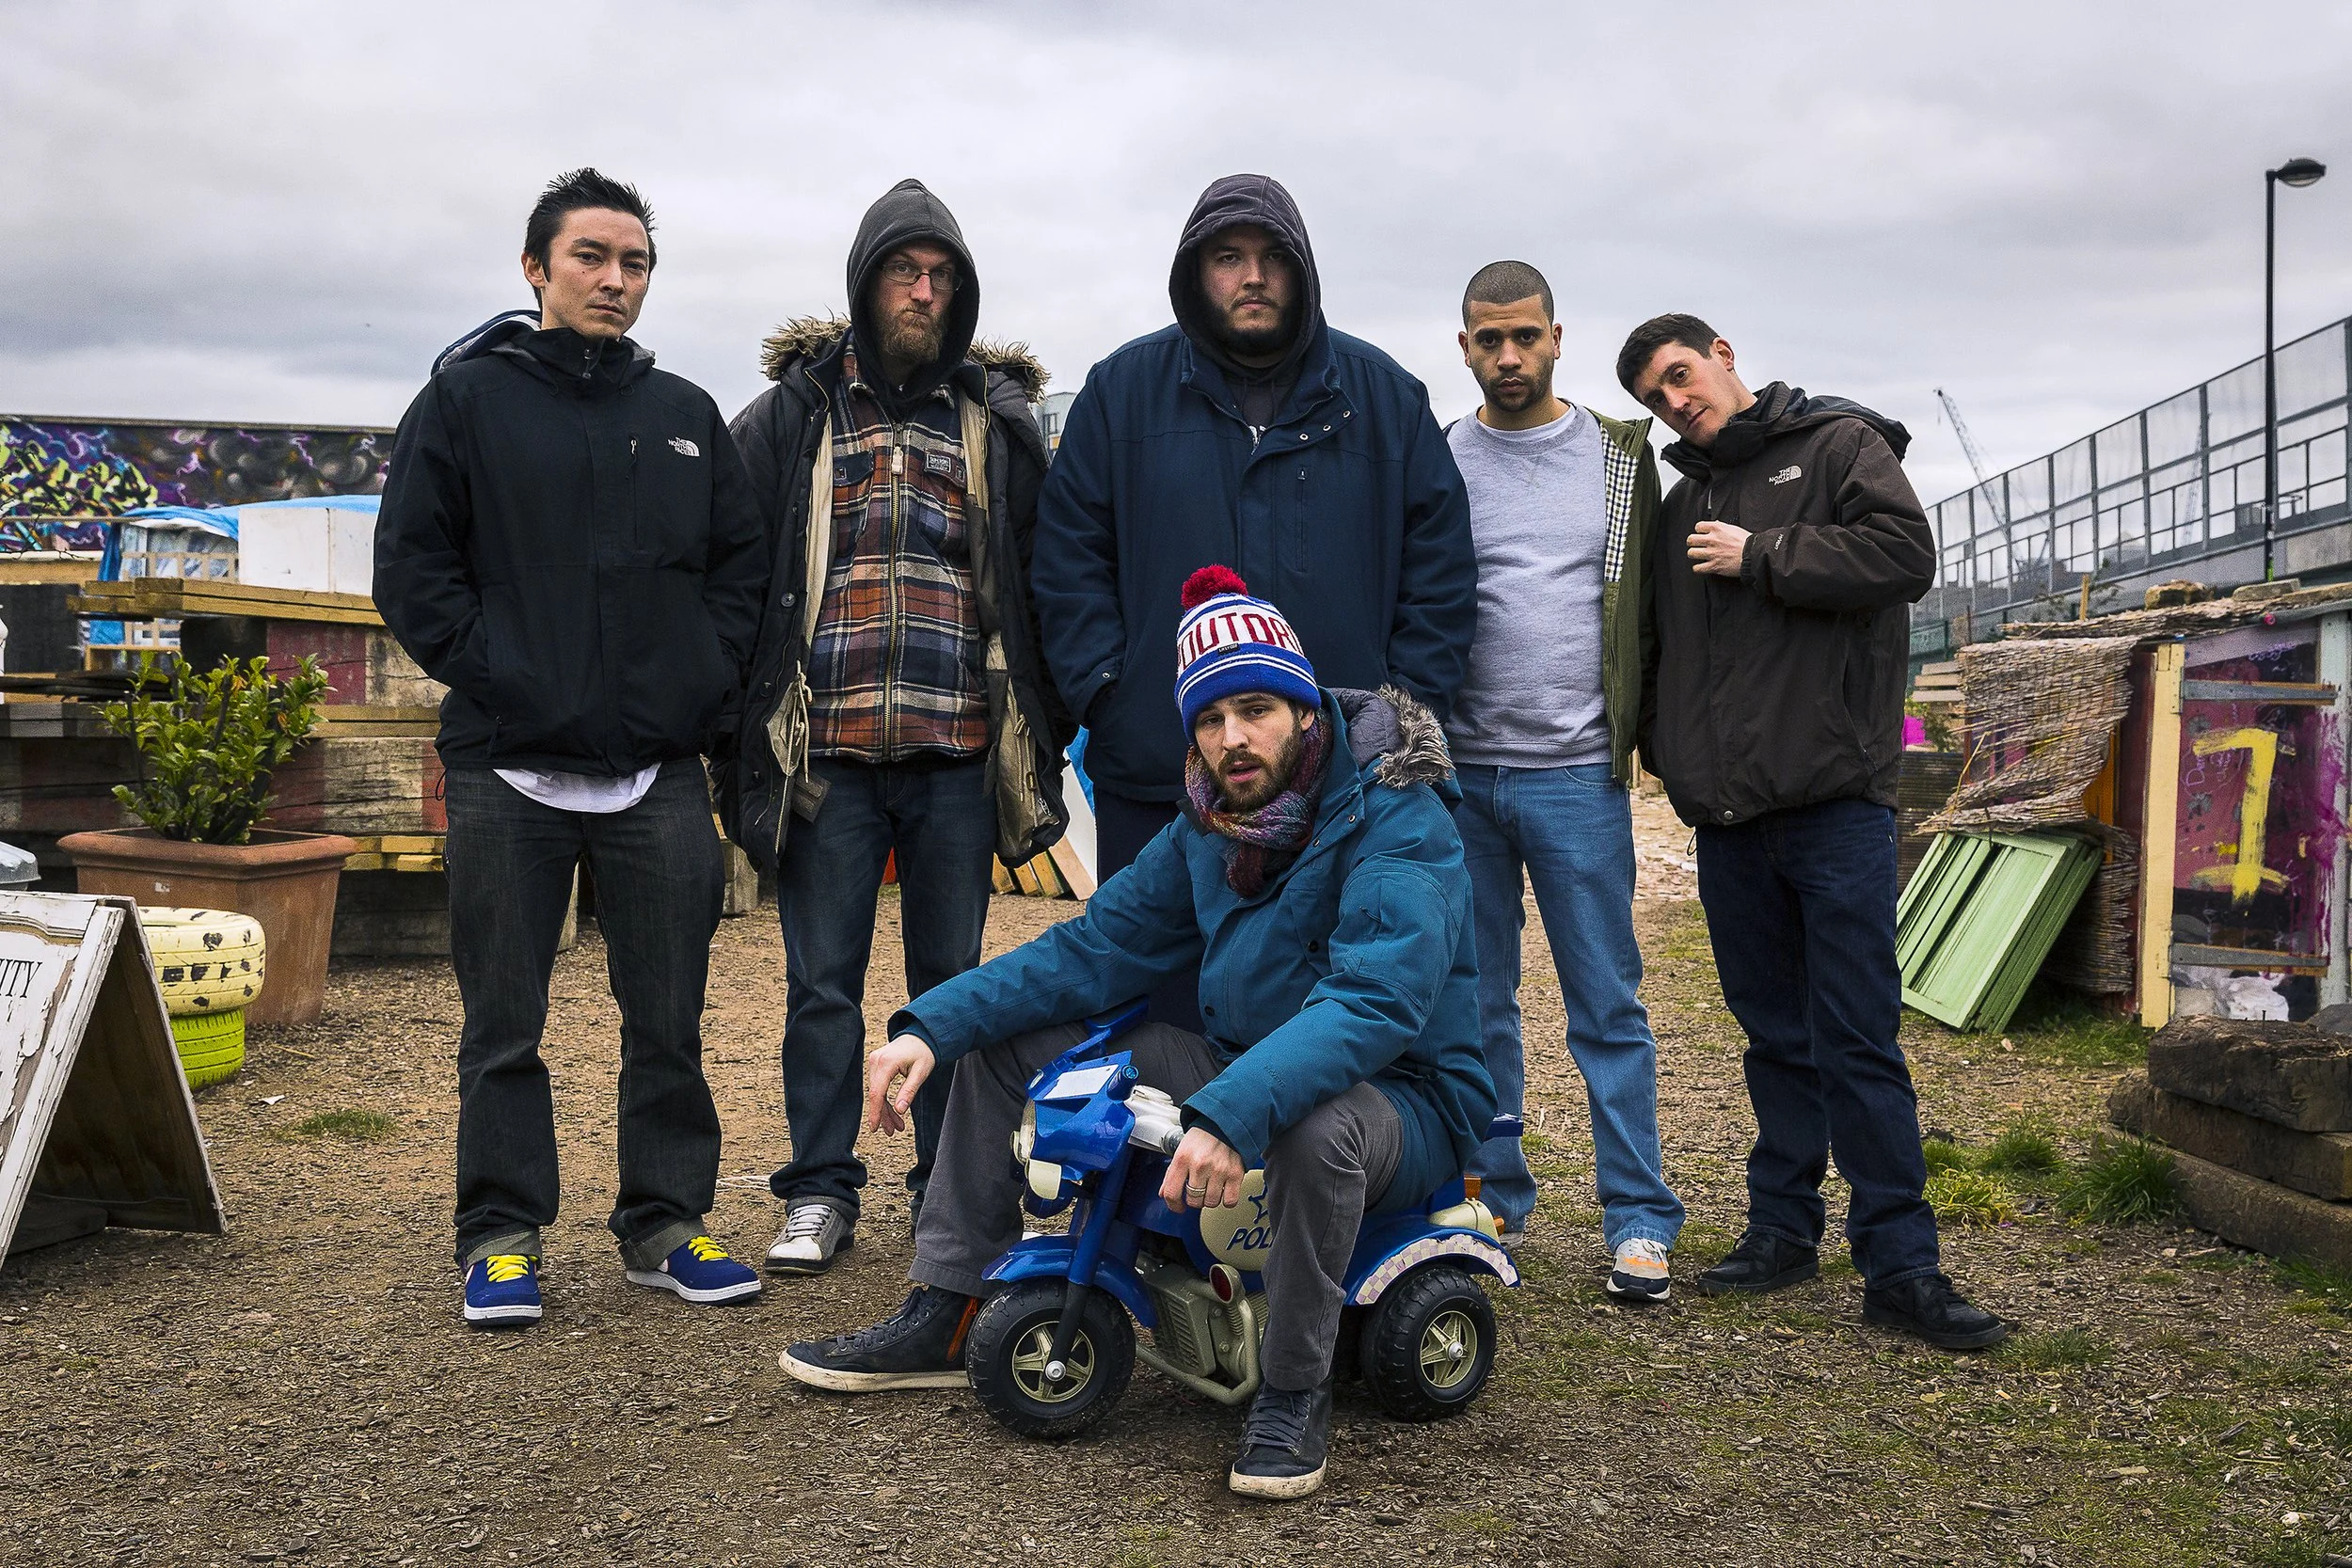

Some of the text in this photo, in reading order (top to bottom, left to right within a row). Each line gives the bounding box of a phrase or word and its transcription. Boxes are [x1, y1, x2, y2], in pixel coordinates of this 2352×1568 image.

[1769, 471, 1791, 483] NORTH
[1778, 467, 1791, 475] THE
[0, 958, 43, 998] ITY
